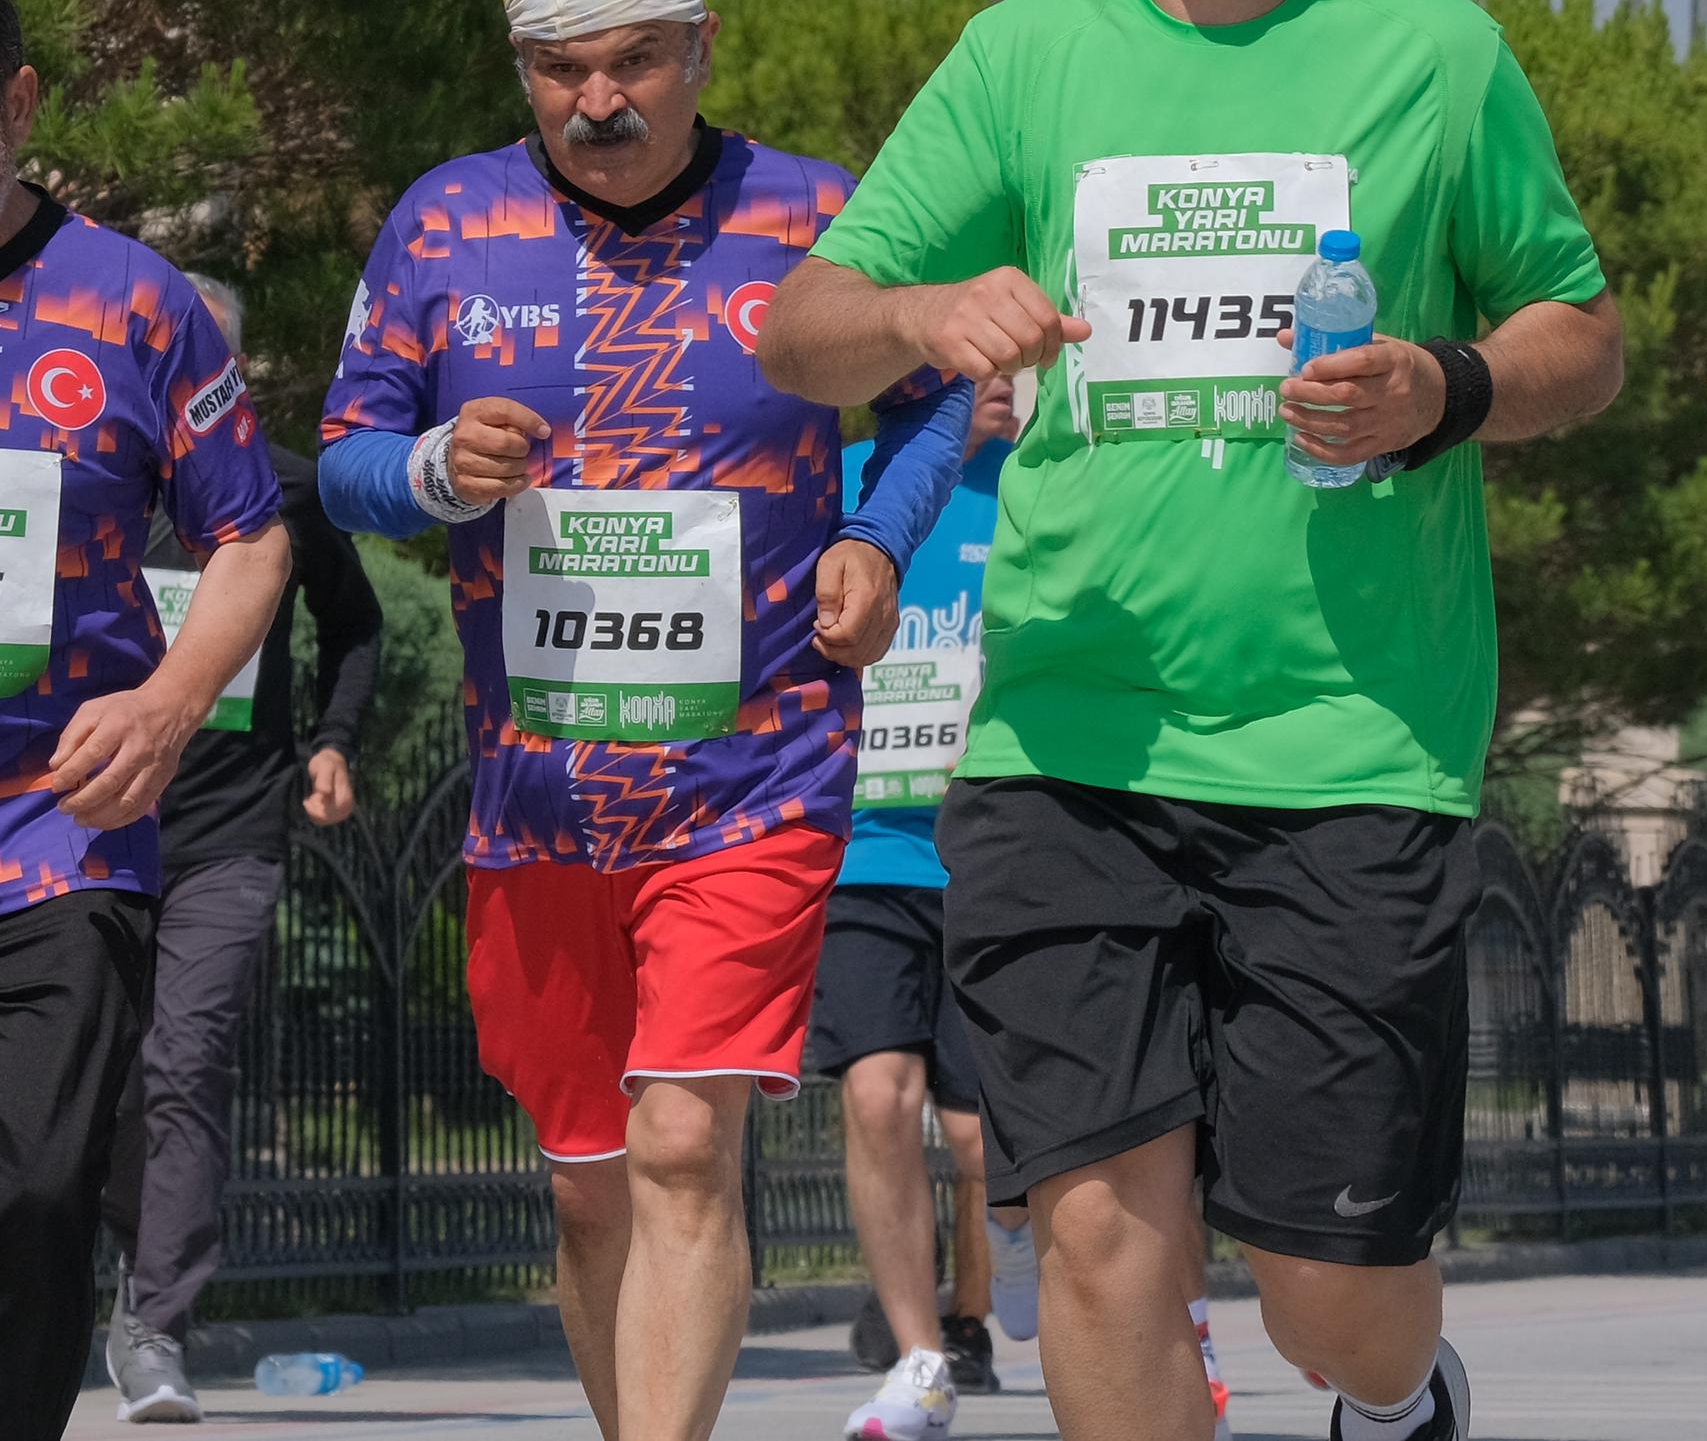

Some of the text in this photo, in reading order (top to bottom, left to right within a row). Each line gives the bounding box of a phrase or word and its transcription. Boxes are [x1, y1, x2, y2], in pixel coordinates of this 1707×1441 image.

[1157, 187, 1266, 209] KONYA
[1173, 209, 1248, 229] YARI
[1119, 230, 1304, 253] MARATONU
[499, 303, 560, 328] YBS
[1127, 295, 1295, 342] 11435
[568, 516, 665, 534] KONYA
[583, 535, 649, 553] YARI
[538, 553, 698, 572] MARATONU
[534, 609, 704, 650] 10368
[874, 664, 932, 678] KONYA
[883, 677, 923, 690] YARI
[860, 723, 958, 751] 10366
